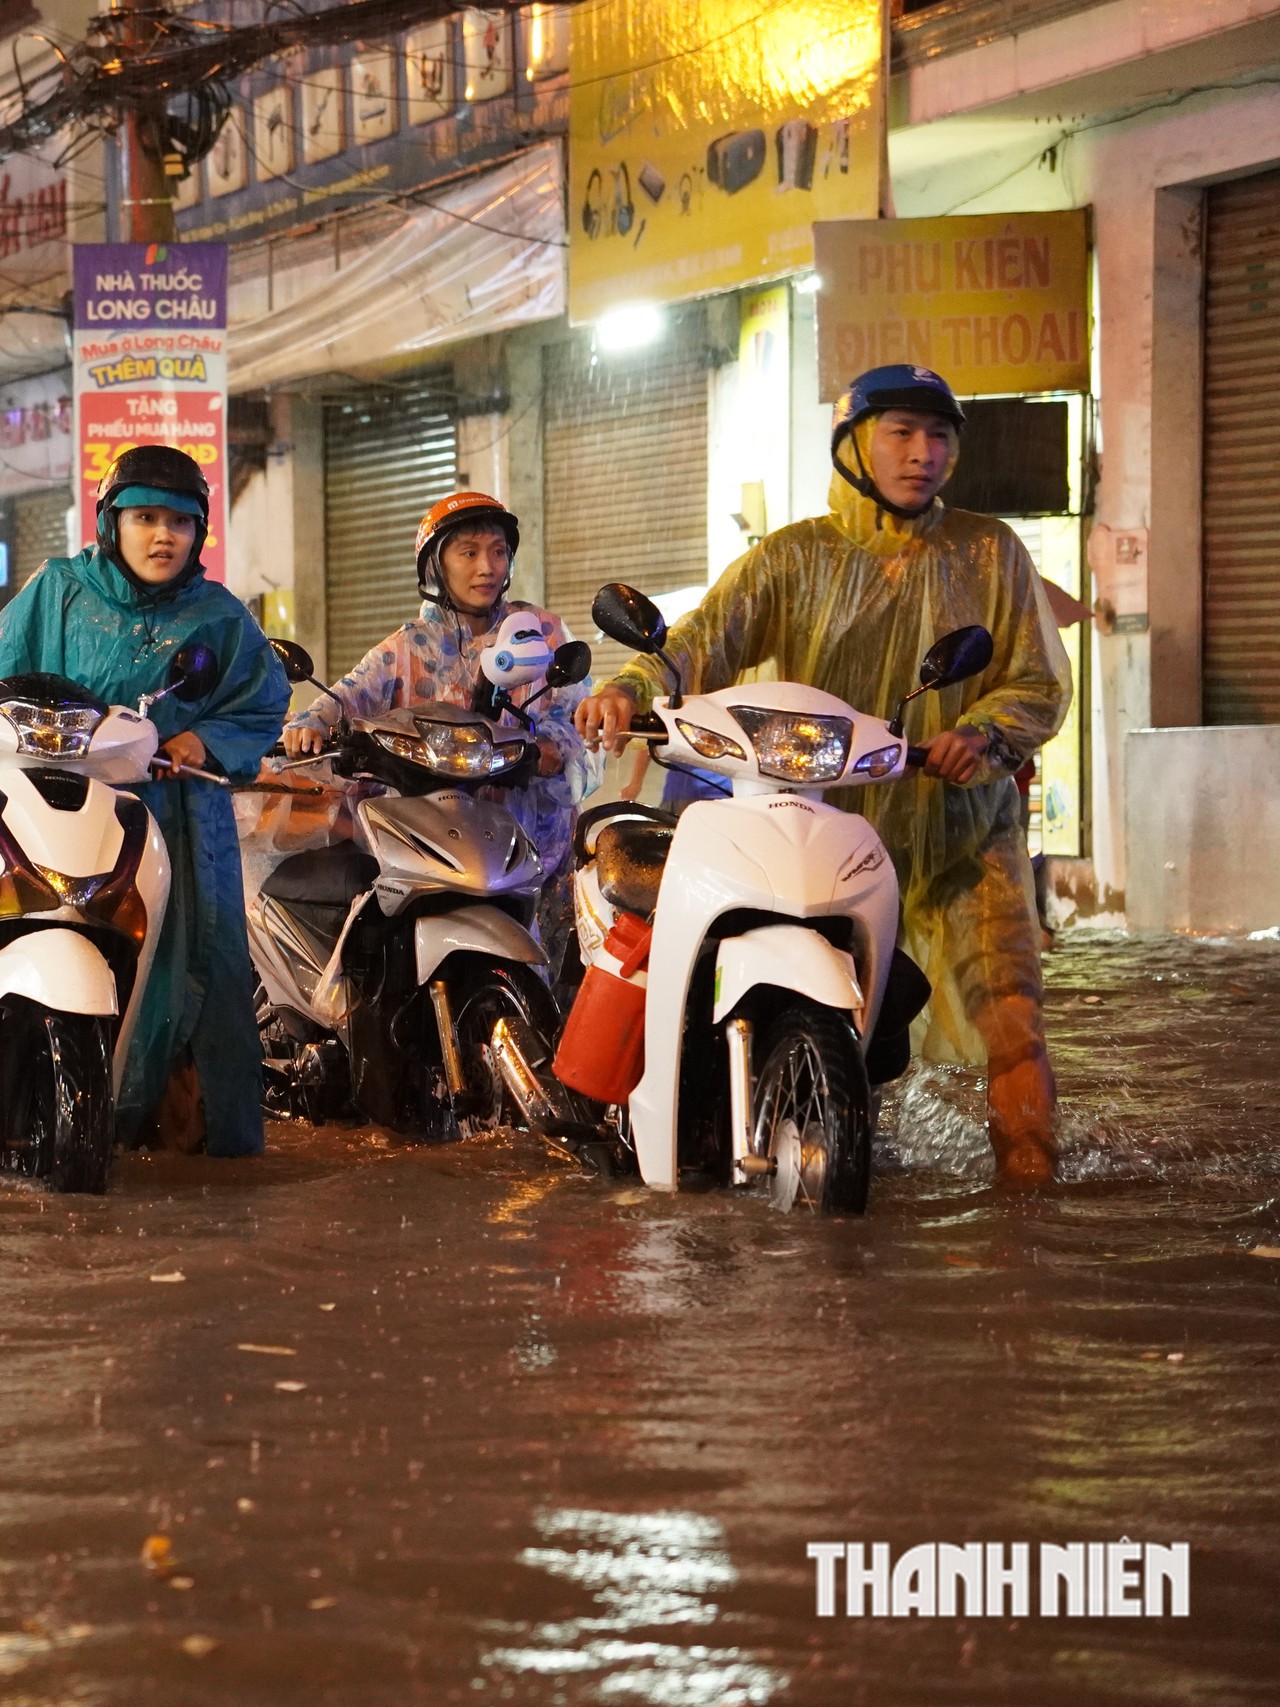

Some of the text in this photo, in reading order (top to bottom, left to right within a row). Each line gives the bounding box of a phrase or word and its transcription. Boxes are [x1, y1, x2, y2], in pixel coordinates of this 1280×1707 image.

[857, 224, 1051, 301] PHỤ KIỆN
[96, 267, 202, 291] NHÀ THUỐC
[86, 294, 217, 320] LONG CHÂU
[81, 342, 118, 359] Mua
[135, 336, 175, 352] Long
[178, 334, 222, 352] Châu
[941, 311, 1080, 374] THOẠI
[90, 354, 207, 387] THÊM QUÀ
[126, 394, 177, 420] TẶNG
[87, 417, 217, 438] PHIẾU MUA HÀNG
[768, 801, 816, 814] HONDA
[377, 884, 405, 896] HONDA
